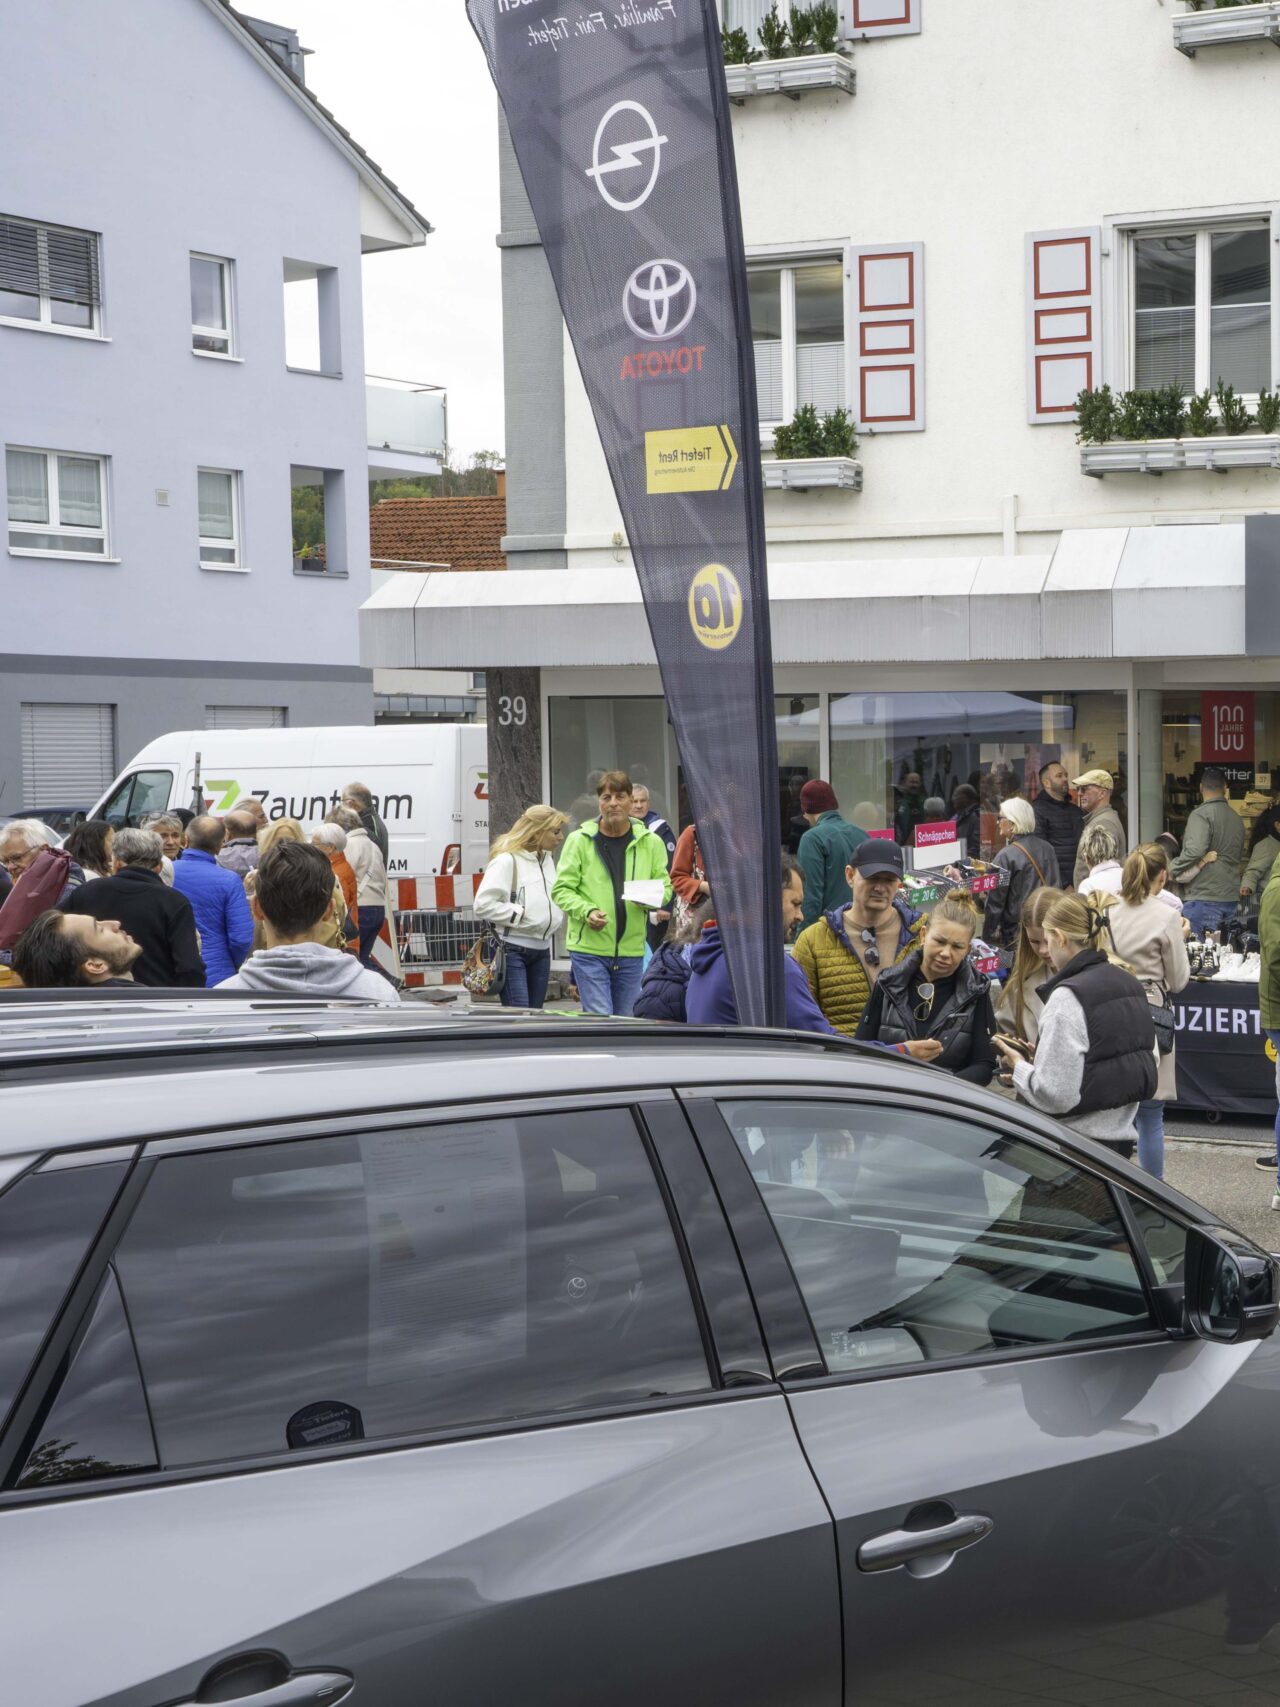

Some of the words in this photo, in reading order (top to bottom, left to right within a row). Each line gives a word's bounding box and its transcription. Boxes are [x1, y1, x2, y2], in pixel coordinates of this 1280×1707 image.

[498, 696, 526, 726] 39
[1212, 705, 1244, 751] 100
[1220, 723, 1244, 733] JAHRE
[251, 789, 413, 821] Zauntm
[917, 829, 956, 843] Schnäppchen
[1172, 1005, 1260, 1035] UZIERT
